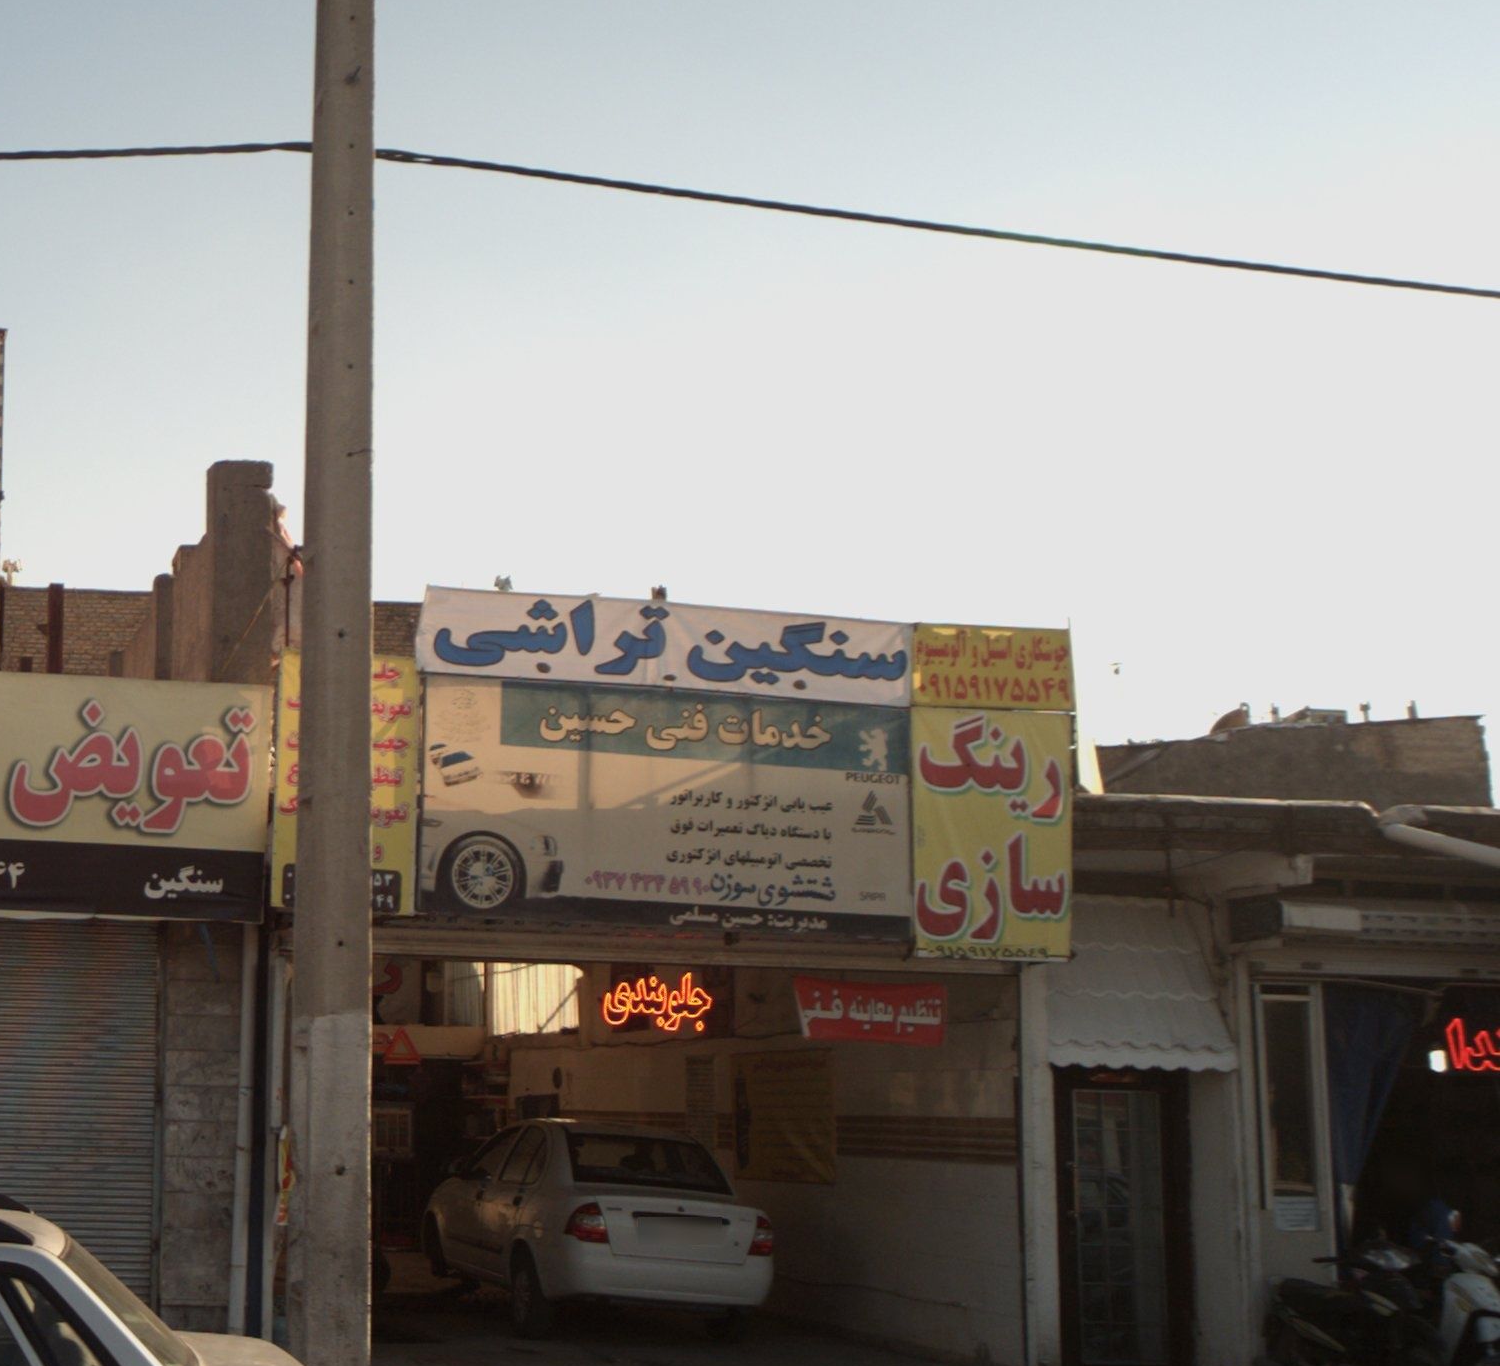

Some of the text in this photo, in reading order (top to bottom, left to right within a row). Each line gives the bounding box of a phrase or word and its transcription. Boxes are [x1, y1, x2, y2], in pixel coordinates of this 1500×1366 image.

[433, 598, 908, 687] سنگین تراشی
[539, 706, 638, 742] حسین
[645, 702, 710, 751] فنی
[717, 708, 833, 750] خدمات
[10, 698, 254, 833] تعویض
[845, 771, 901, 785] PEUGEOT
[918, 714, 1063, 821] رینگ
[144, 865, 224, 899] سنگین
[916, 832, 1065, 941] سازی
[603, 972, 712, 1032] جلوبندی
